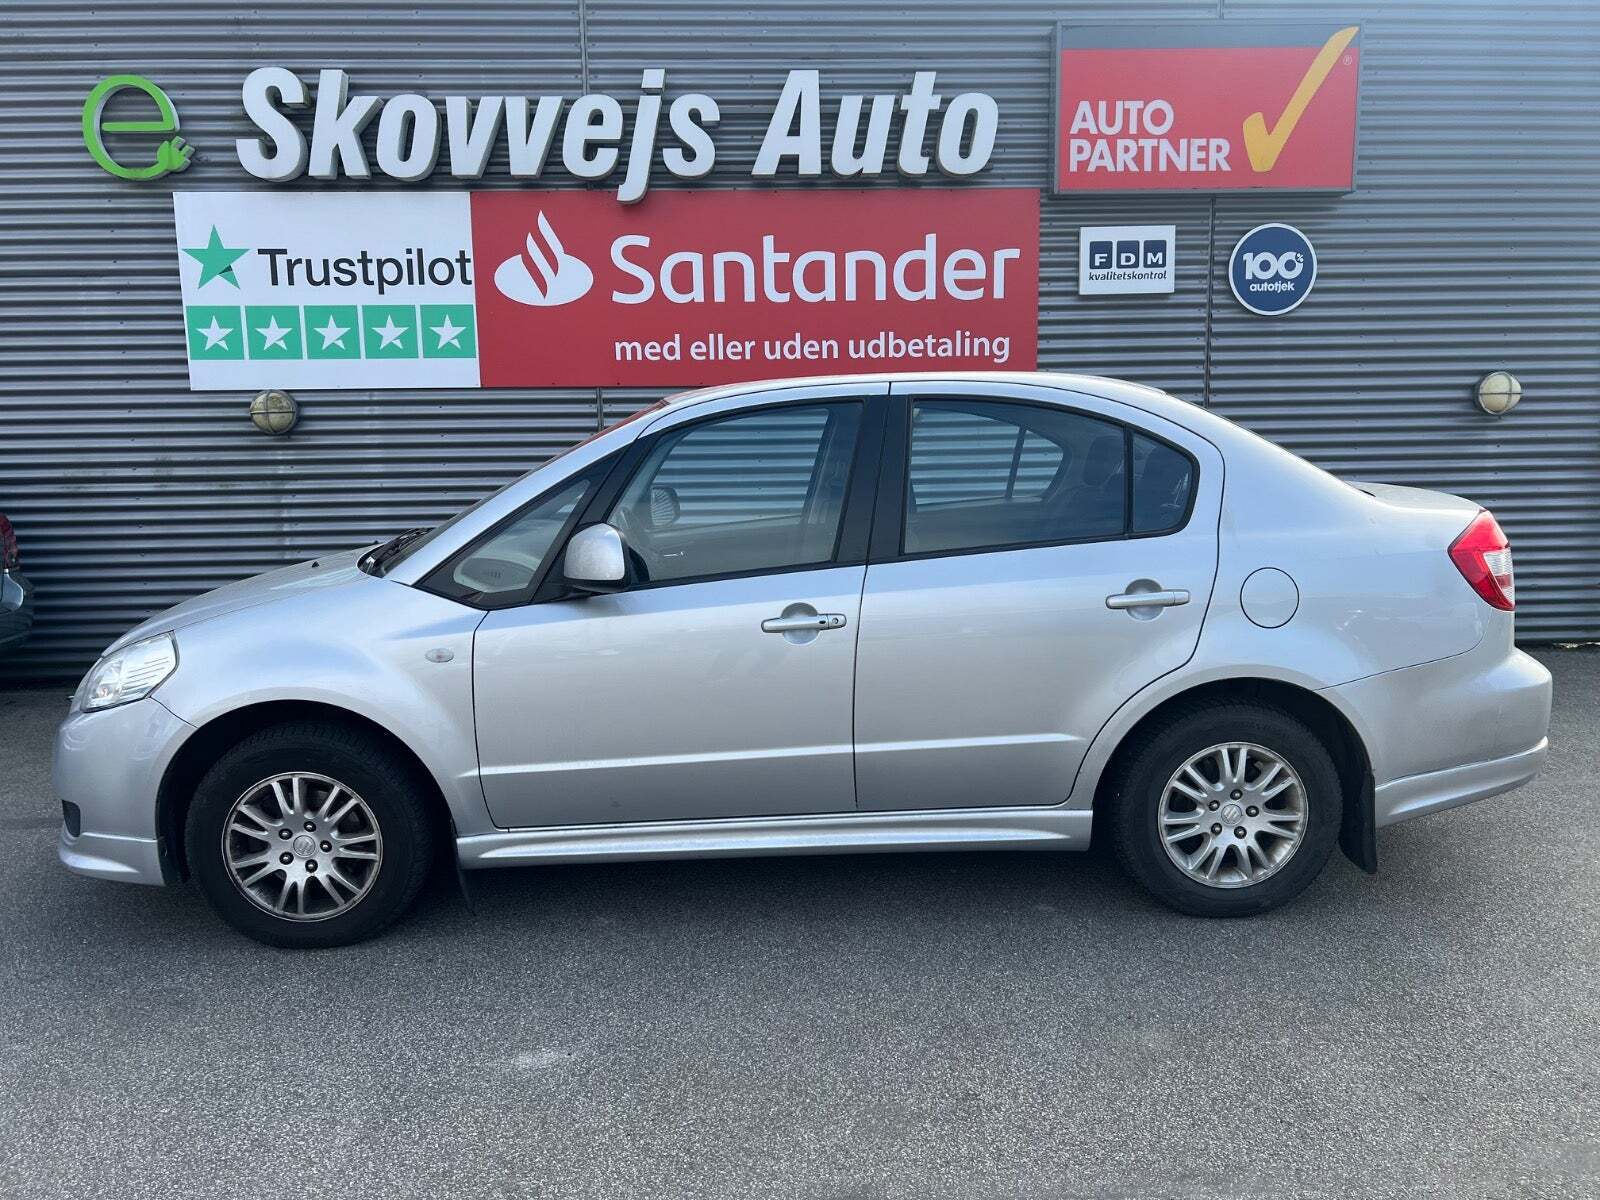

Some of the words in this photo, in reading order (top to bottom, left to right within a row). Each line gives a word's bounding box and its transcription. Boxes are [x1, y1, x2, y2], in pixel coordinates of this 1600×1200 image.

[236, 66, 721, 202] Skovvejs
[752, 69, 999, 178] Auto
[1069, 99, 1174, 135] AUTO
[1068, 138, 1231, 173] PARTNER
[257, 248, 472, 295] Trustpilot
[610, 233, 1020, 304] Santander
[1089, 270, 1167, 281] kvalitetskontrol
[1094, 251, 1164, 267] FDM
[1249, 281, 1295, 294] autotjek
[614, 333, 682, 362] med
[690, 333, 756, 362] eller
[764, 332, 839, 360] uden
[848, 329, 1011, 364] udbetaling
